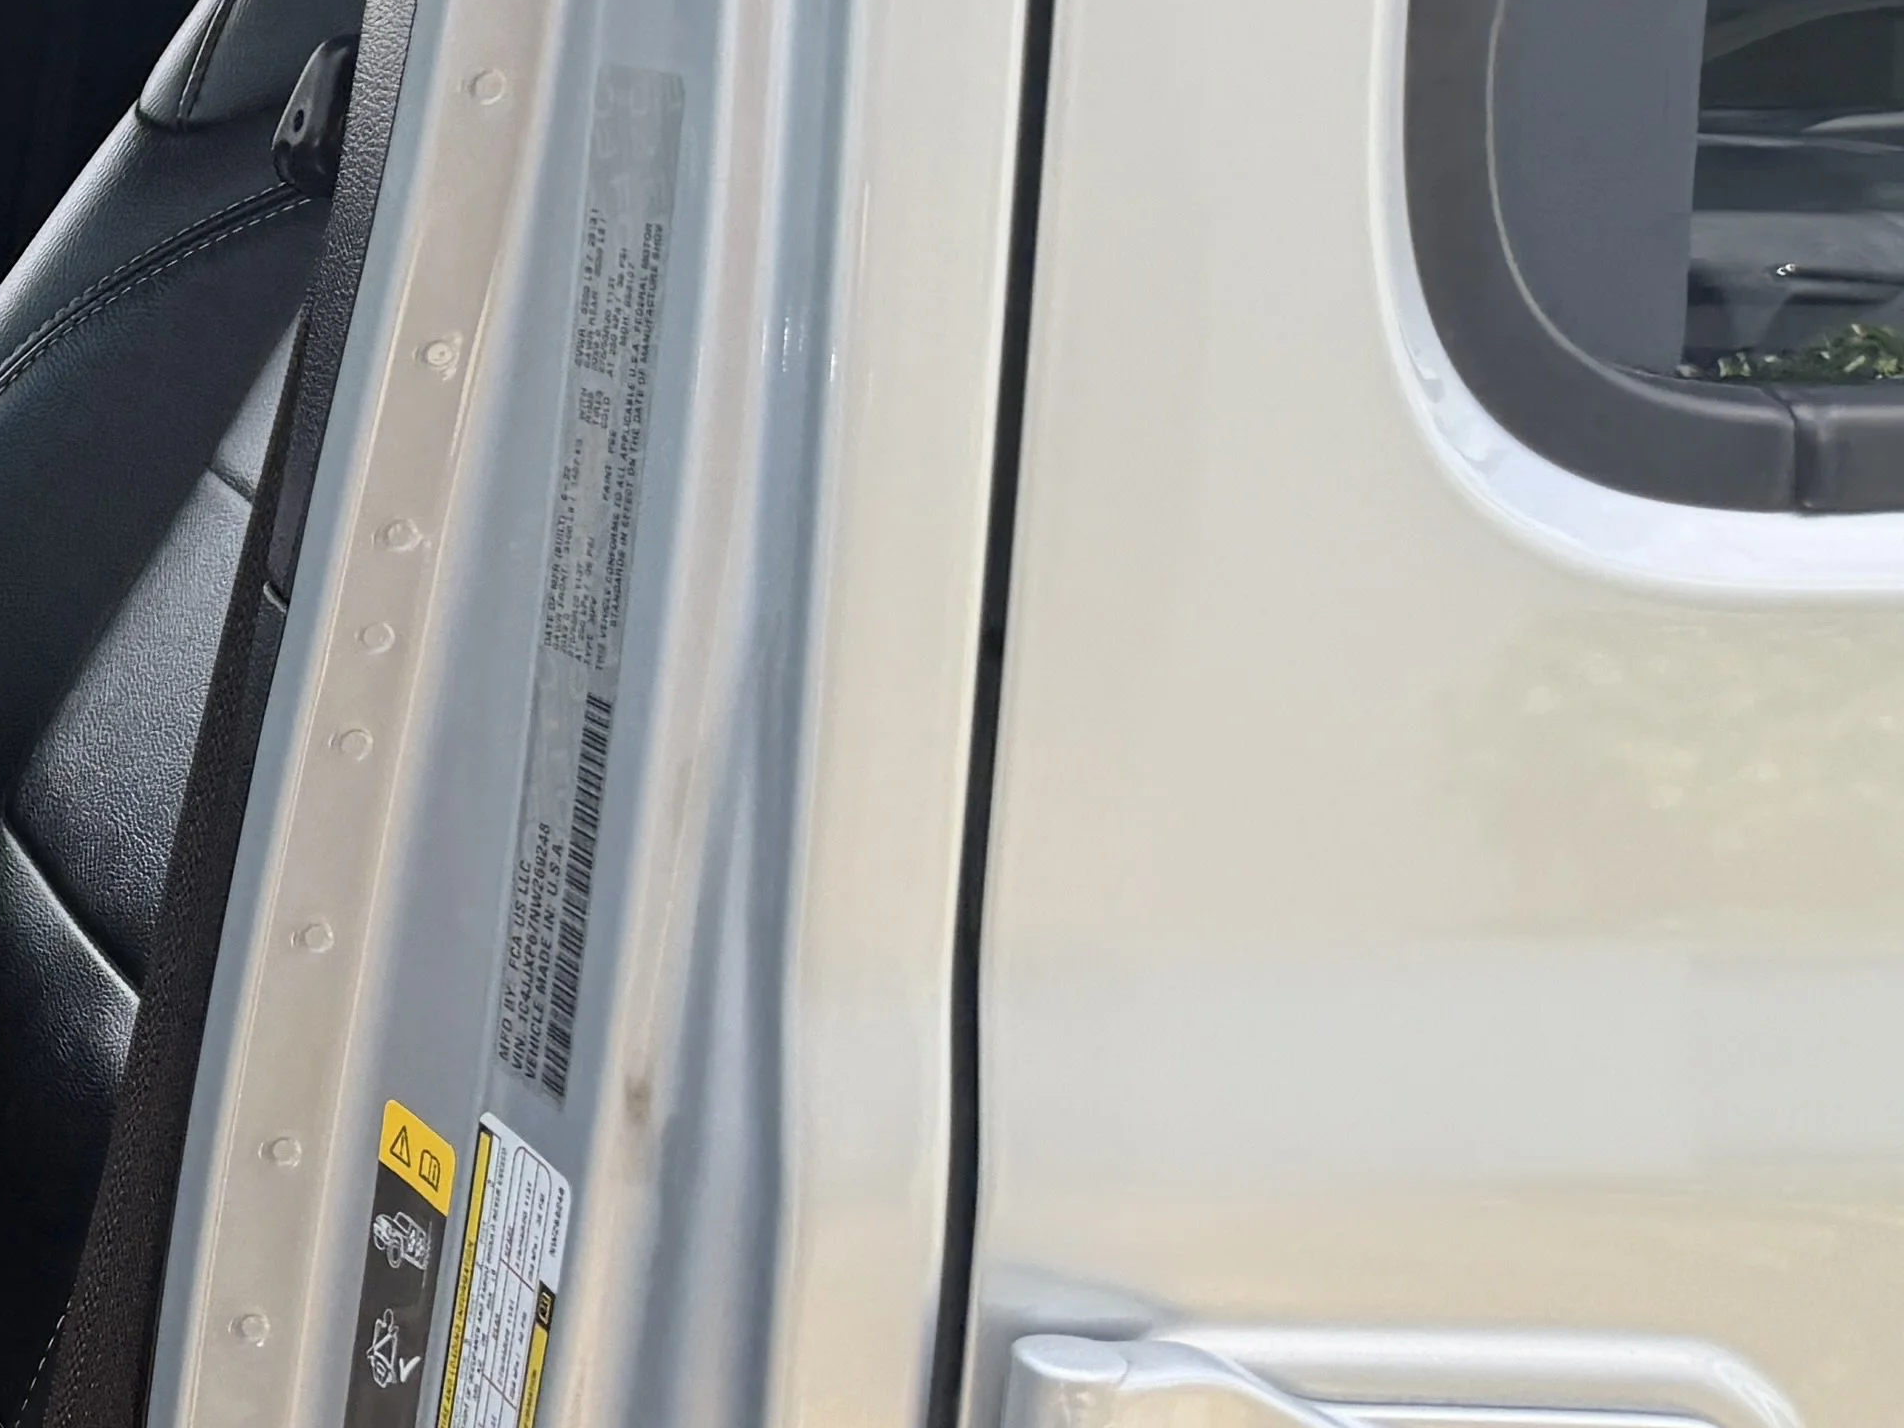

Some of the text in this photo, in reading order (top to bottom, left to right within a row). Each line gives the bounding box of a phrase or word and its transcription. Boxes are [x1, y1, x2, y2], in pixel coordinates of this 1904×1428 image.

[517, 860, 530, 895] LLC
[513, 900, 526, 927] US
[509, 934, 522, 970] FCA
[525, 1001, 543, 1080] VEHICLE
[536, 938, 551, 994] MADE
